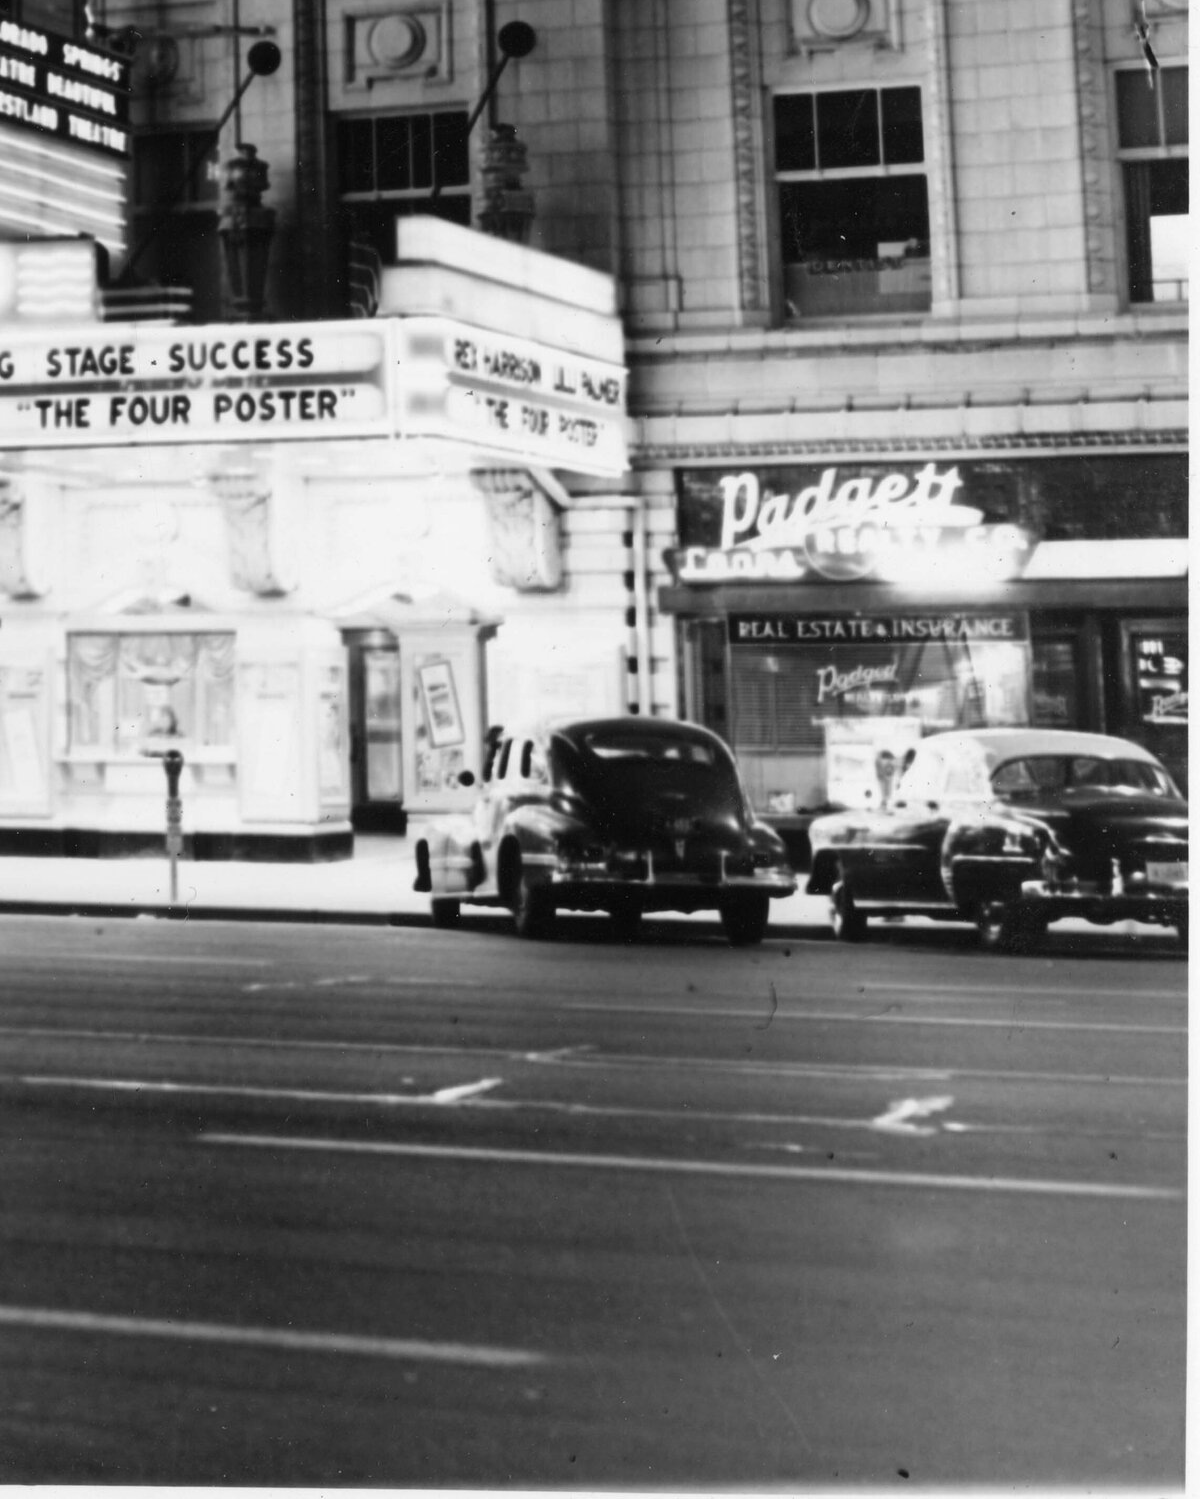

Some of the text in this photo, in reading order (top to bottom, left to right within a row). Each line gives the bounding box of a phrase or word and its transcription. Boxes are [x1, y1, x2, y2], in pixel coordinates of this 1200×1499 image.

[47, 344, 135, 377] STAGE
[168, 338, 315, 371] SUCCESS
[108, 394, 192, 427] FOUR
[212, 387, 357, 423] POSTER"
[719, 461, 965, 551] Padgett
[738, 620, 788, 638] REAL
[797, 618, 873, 638] ESTATE
[892, 616, 1014, 637] INSURANCE
